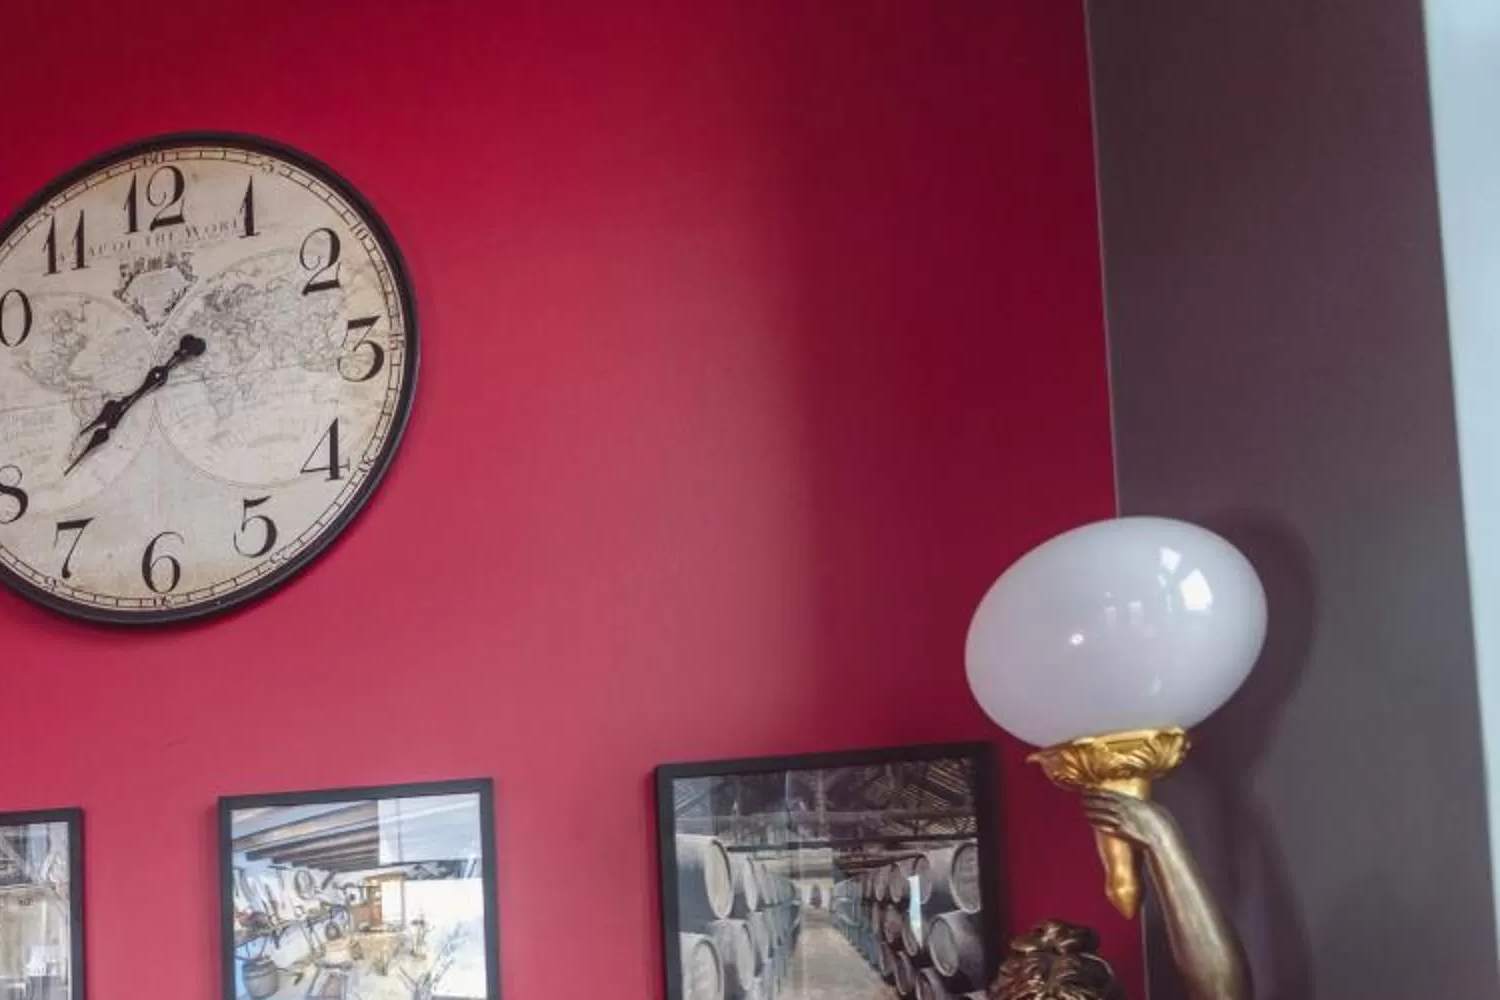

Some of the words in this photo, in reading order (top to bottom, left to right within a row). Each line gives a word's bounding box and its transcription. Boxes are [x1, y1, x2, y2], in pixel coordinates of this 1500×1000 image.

[123, 165, 186, 235] 12
[239, 175, 261, 239] 1
[42, 208, 90, 277] 11
[299, 227, 341, 296] 2
[337, 315, 385, 382] 3
[300, 416, 351, 482] 4
[54, 517, 95, 579] 7
[233, 495, 277, 558] 5
[141, 531, 185, 594] 6
